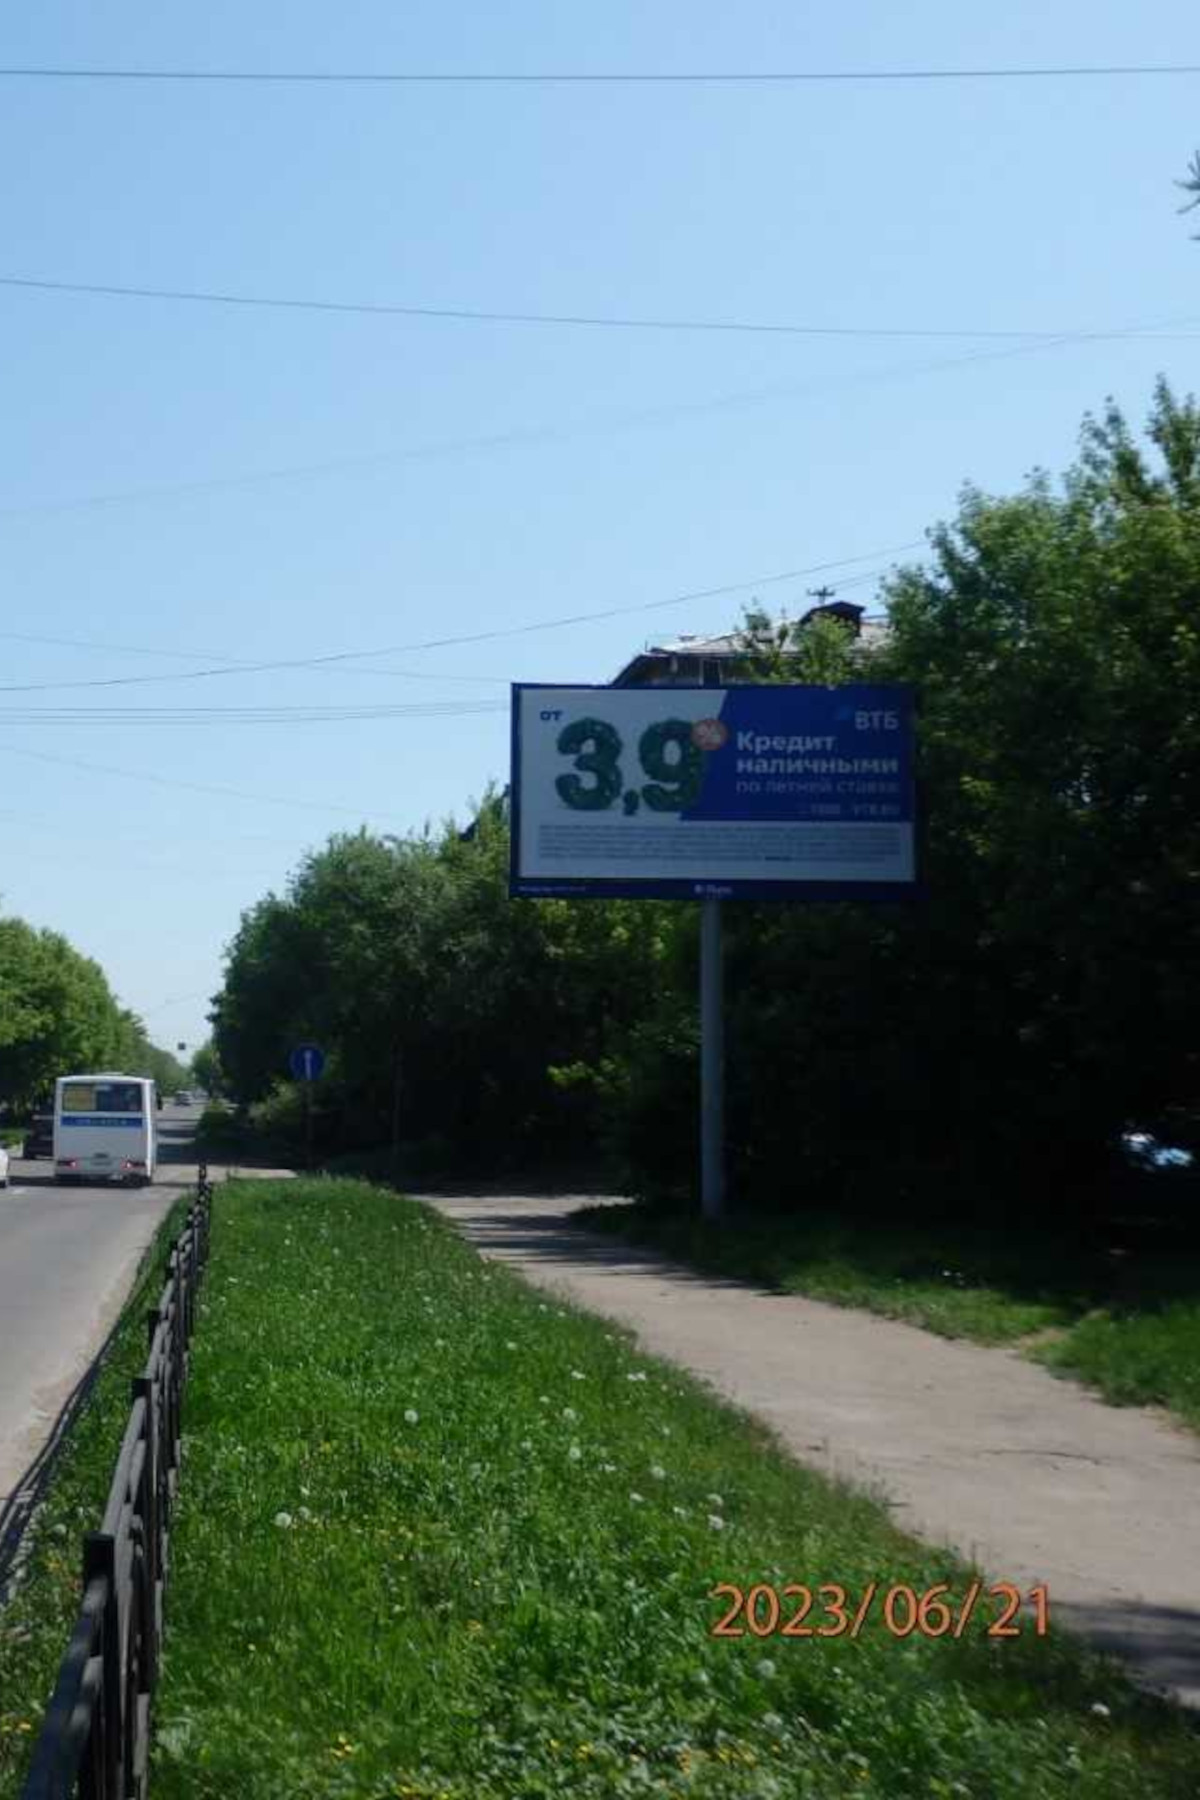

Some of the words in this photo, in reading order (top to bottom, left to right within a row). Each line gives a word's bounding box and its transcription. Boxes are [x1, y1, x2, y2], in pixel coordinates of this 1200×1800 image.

[854, 711, 900, 731] ВТБ
[736, 731, 837, 755] Кредит
[736, 758, 899, 774] наличными
[736, 780, 761, 794] по
